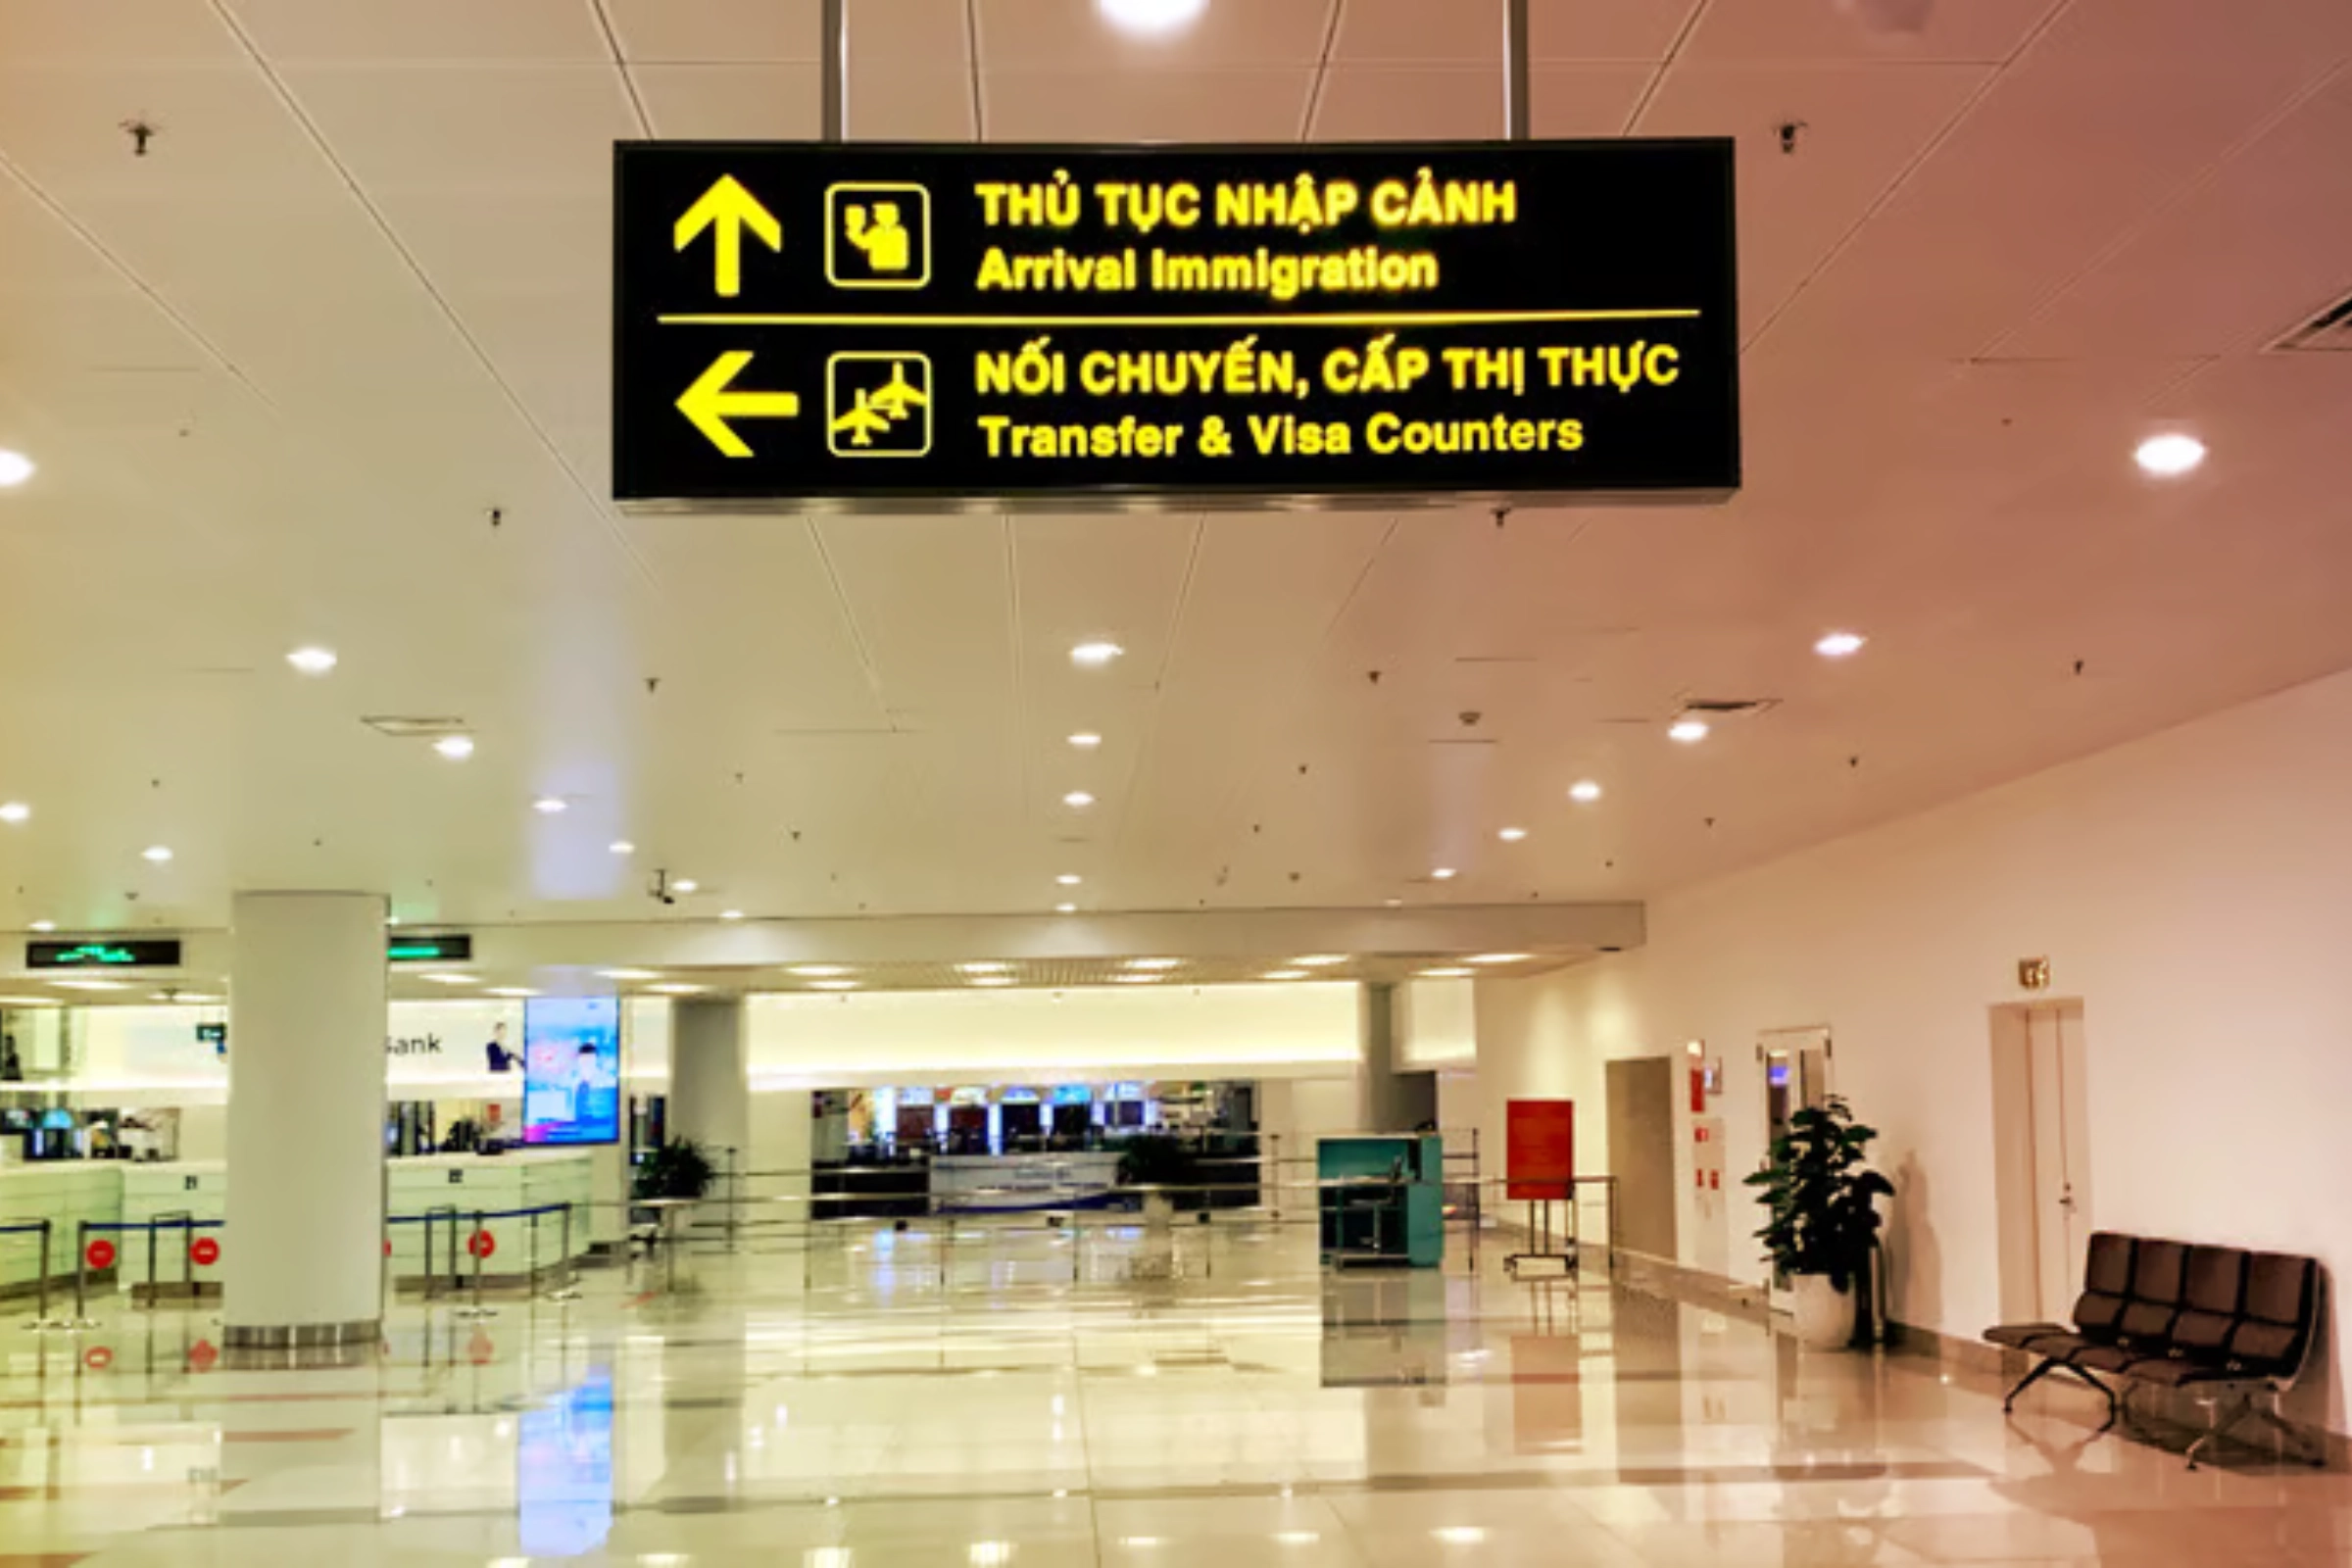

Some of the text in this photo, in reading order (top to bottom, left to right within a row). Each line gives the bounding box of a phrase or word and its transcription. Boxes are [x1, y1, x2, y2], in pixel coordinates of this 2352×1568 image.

[974, 167, 1516, 234] THỦ TỤC NHẬP CẢNH
[976, 245, 1439, 301] Arrival Immigration
[975, 335, 1066, 396] NỐI
[1323, 332, 1430, 392] CẤP
[1442, 347, 1525, 396] THỊ
[1537, 339, 1679, 393] THỰC
[977, 412, 1584, 458] Transfer & Visa Counters
